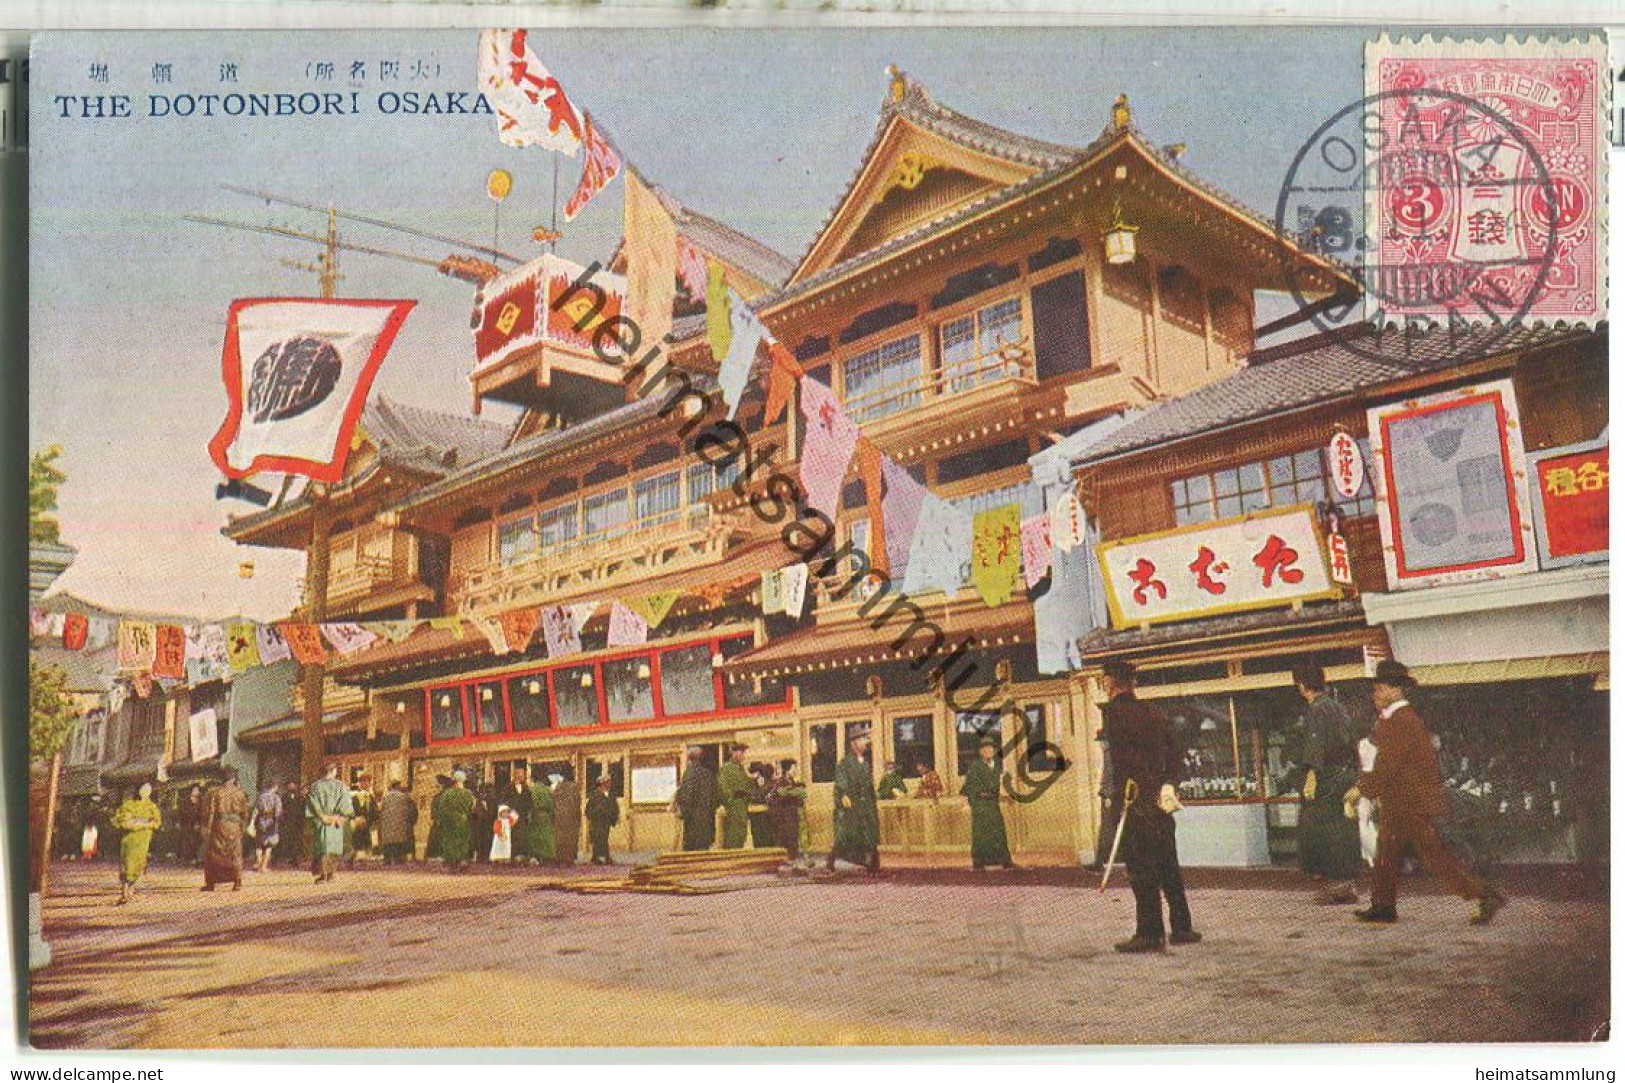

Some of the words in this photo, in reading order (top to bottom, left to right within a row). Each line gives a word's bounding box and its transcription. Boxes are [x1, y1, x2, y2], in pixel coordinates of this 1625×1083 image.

[54, 94, 132, 118] THE
[148, 92, 360, 117] DOTONBORI
[377, 91, 494, 115] OSAKA
[1402, 181, 1436, 226] 3
